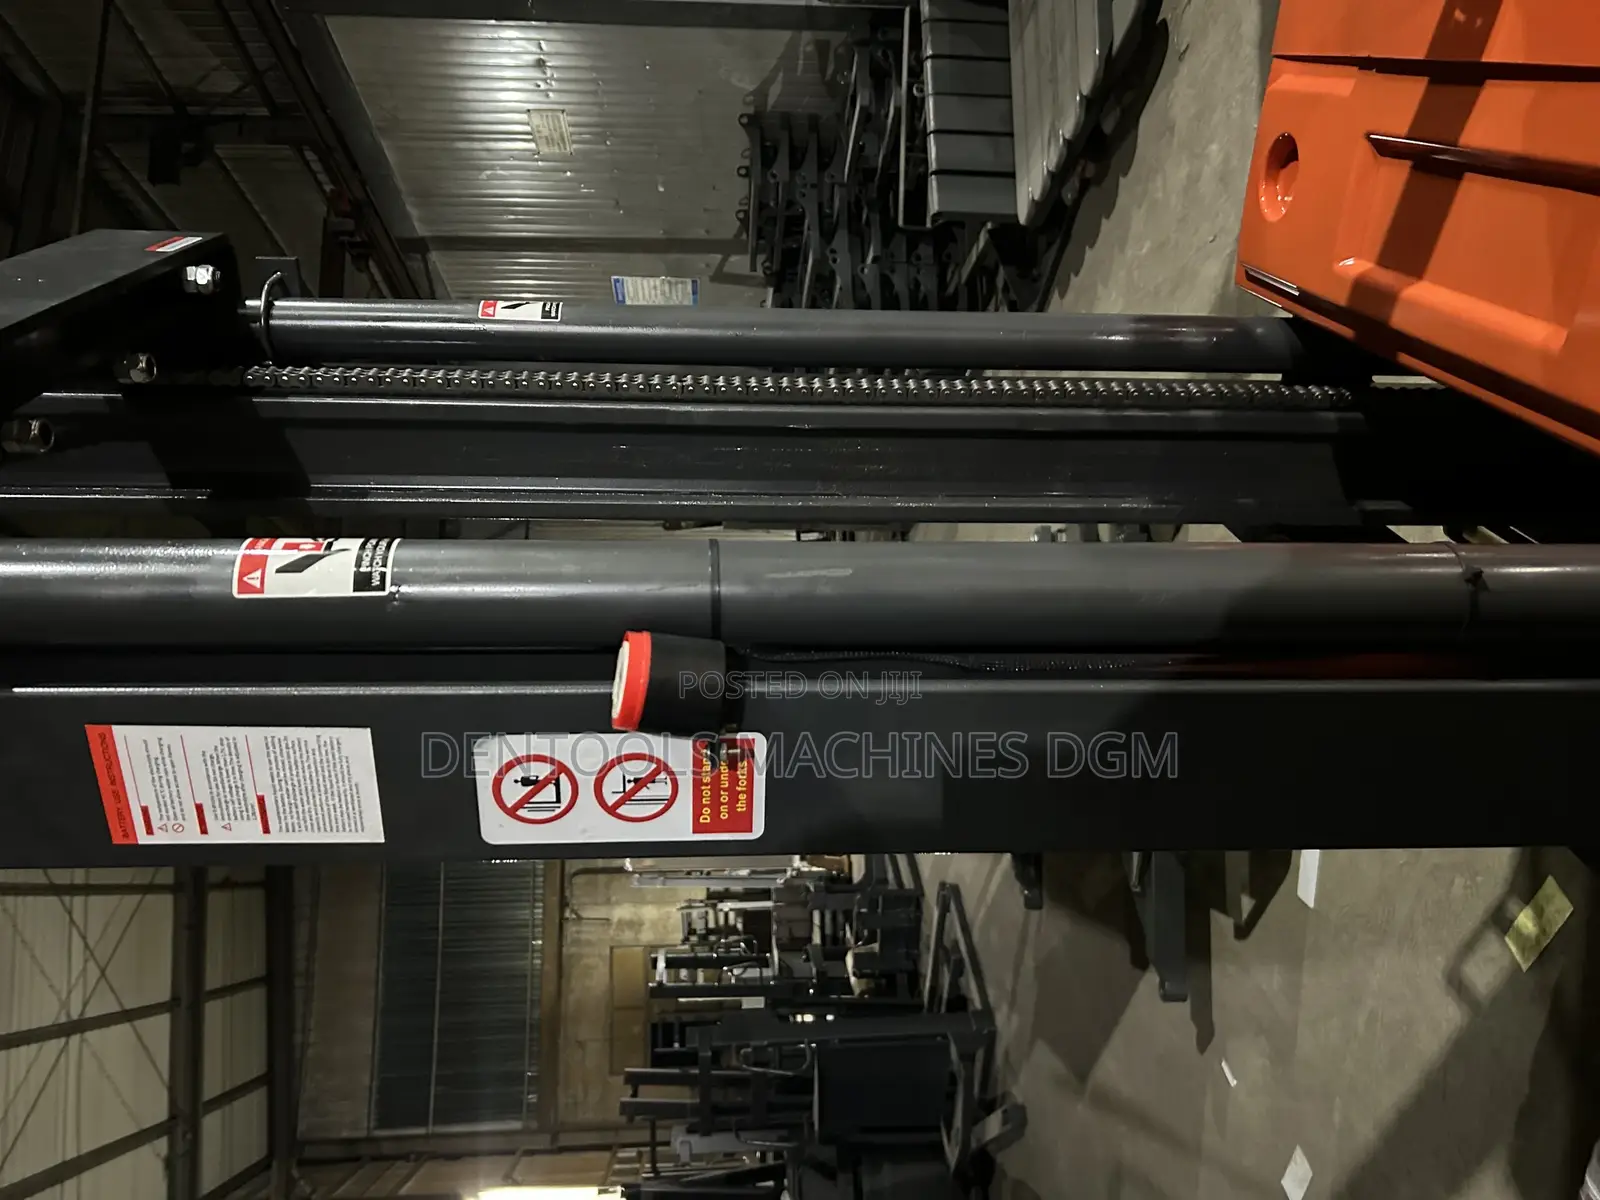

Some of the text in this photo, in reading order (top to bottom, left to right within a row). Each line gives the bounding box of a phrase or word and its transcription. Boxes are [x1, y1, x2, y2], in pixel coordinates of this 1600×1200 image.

[371, 556, 382, 586] WATCH
[701, 785, 711, 804] not
[720, 760, 728, 819] on or und
[736, 760, 747, 812] the forks
[114, 807, 130, 839] BATTERY
[699, 807, 711, 823] Do
